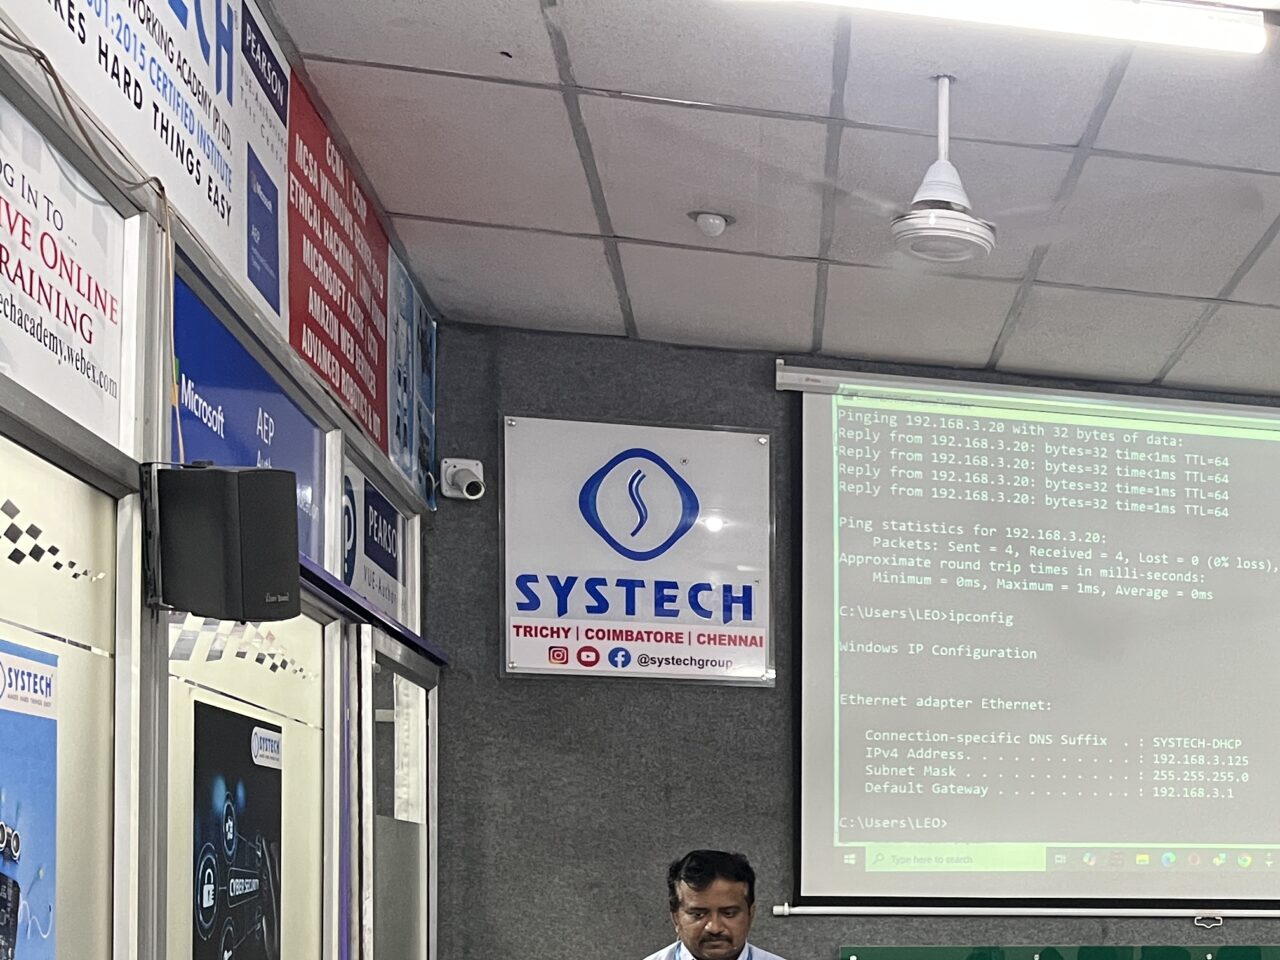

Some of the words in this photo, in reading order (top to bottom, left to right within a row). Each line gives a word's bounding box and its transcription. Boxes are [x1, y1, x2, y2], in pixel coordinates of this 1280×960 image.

[246, 22, 284, 107] PEARSON
[176, 50, 212, 120] ACADEMY
[98, 35, 144, 110] HARD
[152, 102, 201, 186] THINGS
[207, 175, 232, 227] EASY
[149, 57, 195, 135] CERTIFIED
[196, 123, 232, 193] INSTITUTE
[20, 174, 40, 210] IN
[44, 195, 65, 232] TO
[295, 133, 319, 192] MCSA
[319, 168, 354, 241] WINDOWS
[289, 170, 322, 240] ETHICAL
[323, 216, 354, 283] HACKING
[40, 231, 119, 326] ONLINE
[303, 233, 346, 312] MICROSOFT
[309, 285, 339, 346] AMAZON
[340, 323, 355, 365] WEB
[302, 323, 341, 389] ADVANCED
[181, 373, 225, 439] Microsoft
[256, 407, 275, 446] AEP
[838, 411, 898, 427] Pinging
[906, 415, 1005, 433] 192.168.3.20
[1013, 422, 1045, 436] with
[1053, 427, 1069, 438] 32
[1076, 428, 1116, 442] bytes
[1123, 431, 1139, 442] of
[1146, 434, 1184, 447] data:
[839, 428, 880, 445] Reply
[890, 432, 923, 446] from
[931, 435, 1036, 452] 192.168.3.20:
[1045, 442, 1108, 460] bytes=32
[1116, 448, 1176, 463] time<1ms
[1185, 454, 1229, 467] TTL=64
[839, 446, 880, 462] Reply
[890, 450, 923, 463] from
[931, 453, 1036, 470] 192.168.3.20:
[1045, 459, 1108, 477] bytes=32
[1116, 465, 1176, 480] time<1ms
[1185, 471, 1229, 484] TTL=64
[839, 464, 880, 480] Reply
[890, 468, 923, 481] from
[931, 470, 1036, 488] 192.168.3.20:
[1045, 477, 1108, 494] bytes=32
[1116, 482, 1176, 496] time=1ms
[1185, 488, 1229, 501] TTL=64
[839, 481, 880, 497] Reply
[890, 485, 923, 498] from
[931, 488, 1036, 505] 192.168.3.20:
[1045, 494, 1108, 511] bytes=32
[1116, 499, 1176, 513] time=1ms
[1185, 505, 1229, 518] TTL=64
[839, 517, 873, 532] Ping
[882, 519, 964, 535] statistics
[974, 524, 997, 537] for
[1006, 528, 1107, 544] 192.168.3.20:
[839, 553, 931, 570] Approximate
[940, 558, 980, 572] round
[989, 561, 1021, 576] trip
[1029, 562, 1069, 576] times
[1077, 565, 1092, 577] in
[1100, 566, 1206, 584] milli-seconds:
[873, 537, 938, 551] Packets:
[948, 541, 980, 553] Sent
[1005, 544, 1020, 557] 4,
[1029, 546, 1093, 560] Received
[1115, 551, 1130, 564] 4,
[1138, 553, 1169, 565] Lost
[1207, 555, 1230, 570] (0%
[1237, 556, 1279, 573] loss),
[515, 573, 753, 625] SYSTECH
[872, 572, 932, 585] Minimum
[956, 576, 987, 590] 0ms,
[996, 578, 1053, 591] Maximum
[1077, 582, 1106, 596] 1ms,
[1115, 585, 1169, 599] Average
[1191, 589, 1213, 601] 0ms
[839, 605, 1014, 626] C:\Users\LEO>ipconfig
[513, 625, 571, 639] TRICHY
[585, 628, 684, 644] COIMBATORE
[697, 633, 764, 648] CHENNAI
[840, 642, 898, 654] Windows
[908, 644, 924, 654] IP
[932, 644, 1038, 660] Configuration
[637, 653, 733, 669] @systechgroup
[8, 666, 52, 699] SYSTECH
[840, 694, 906, 708] Ethernet
[916, 696, 973, 710] adapter
[981, 697, 1052, 711] Ethernet:
[259, 736, 280, 754] SYSTECH
[865, 729, 1021, 746] Connection-specific
[1029, 734, 1053, 745] DNS
[1061, 734, 1108, 746] Suffix
[1153, 737, 1243, 749] SYSTECH-DHCP
[865, 748, 899, 759] IPv4
[1153, 754, 1249, 766] 192.168.3.125
[865, 764, 915, 777] Subnet
[924, 765, 956, 777] Mask
[1153, 771, 1249, 782] 255.255.255.0
[865, 781, 924, 794] Default
[932, 782, 988, 798] Gateway
[1153, 787, 1234, 798] 192.168.3.1
[839, 817, 948, 830] C:\Users\LEO>
[911, 854, 929, 864] here
[932, 855, 943, 864] to
[946, 854, 973, 864] search
